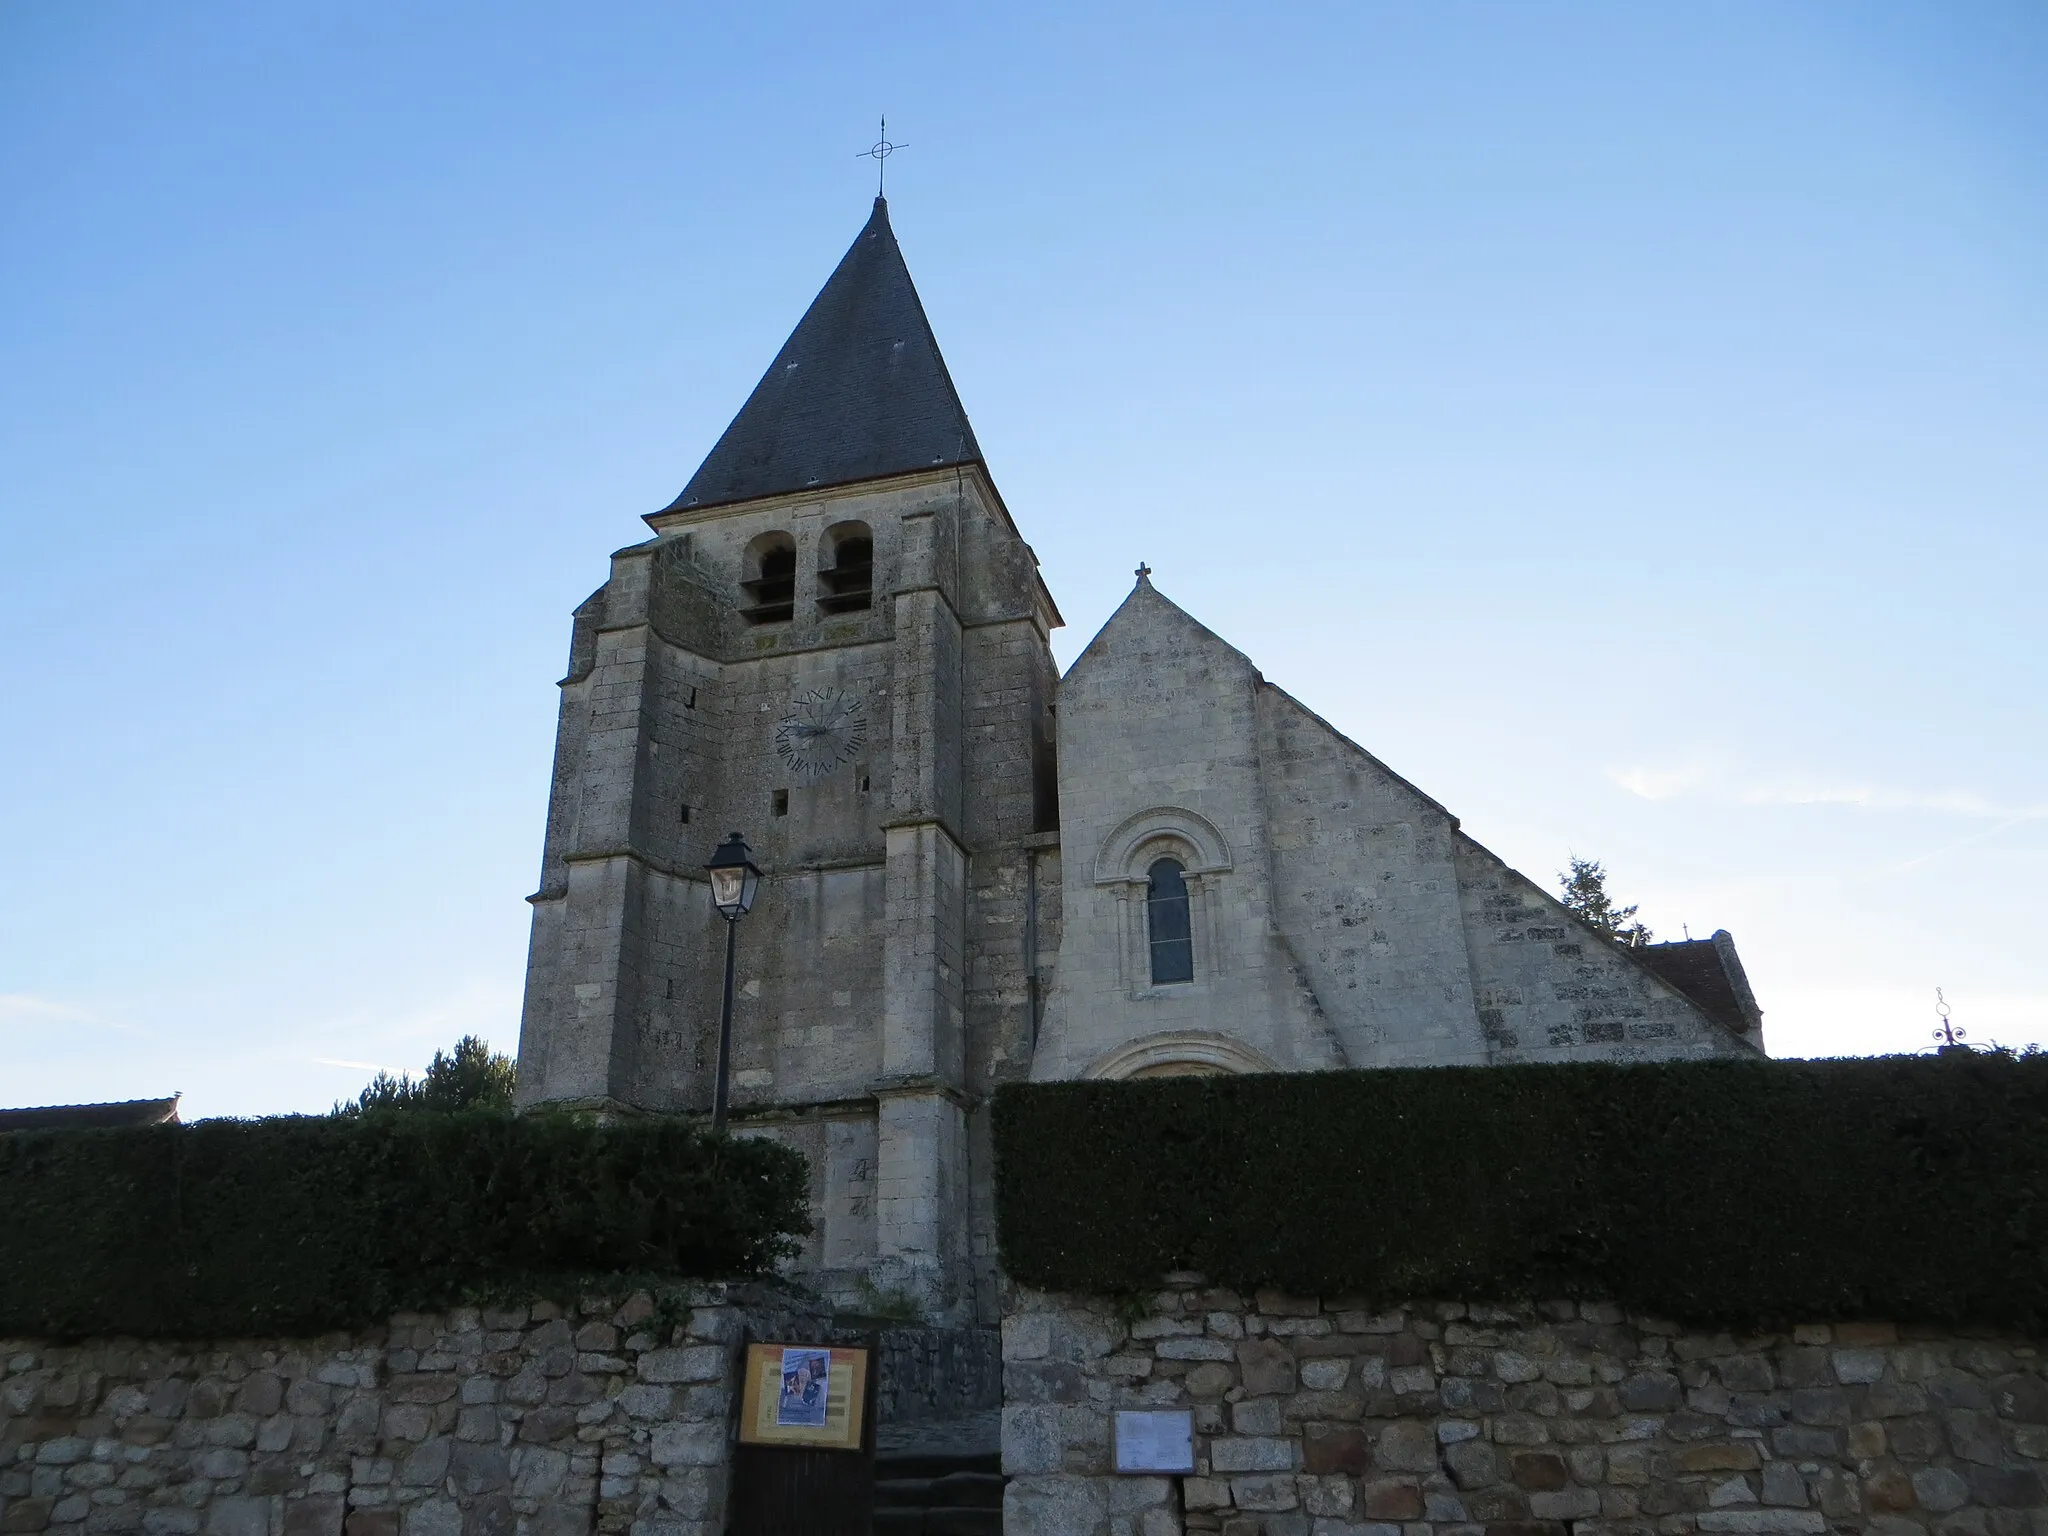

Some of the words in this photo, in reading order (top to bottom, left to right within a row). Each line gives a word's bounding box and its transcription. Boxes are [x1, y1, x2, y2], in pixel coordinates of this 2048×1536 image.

[811, 687, 833, 700] XII
[793, 692, 812, 710] XI
[847, 701, 862, 713] II
[780, 710, 796, 724] X
[853, 719, 867, 731] III
[844, 736, 864, 755] IIII
[791, 757, 809, 775] VII
[813, 762, 830, 775] VI
[835, 756, 848, 770] V
